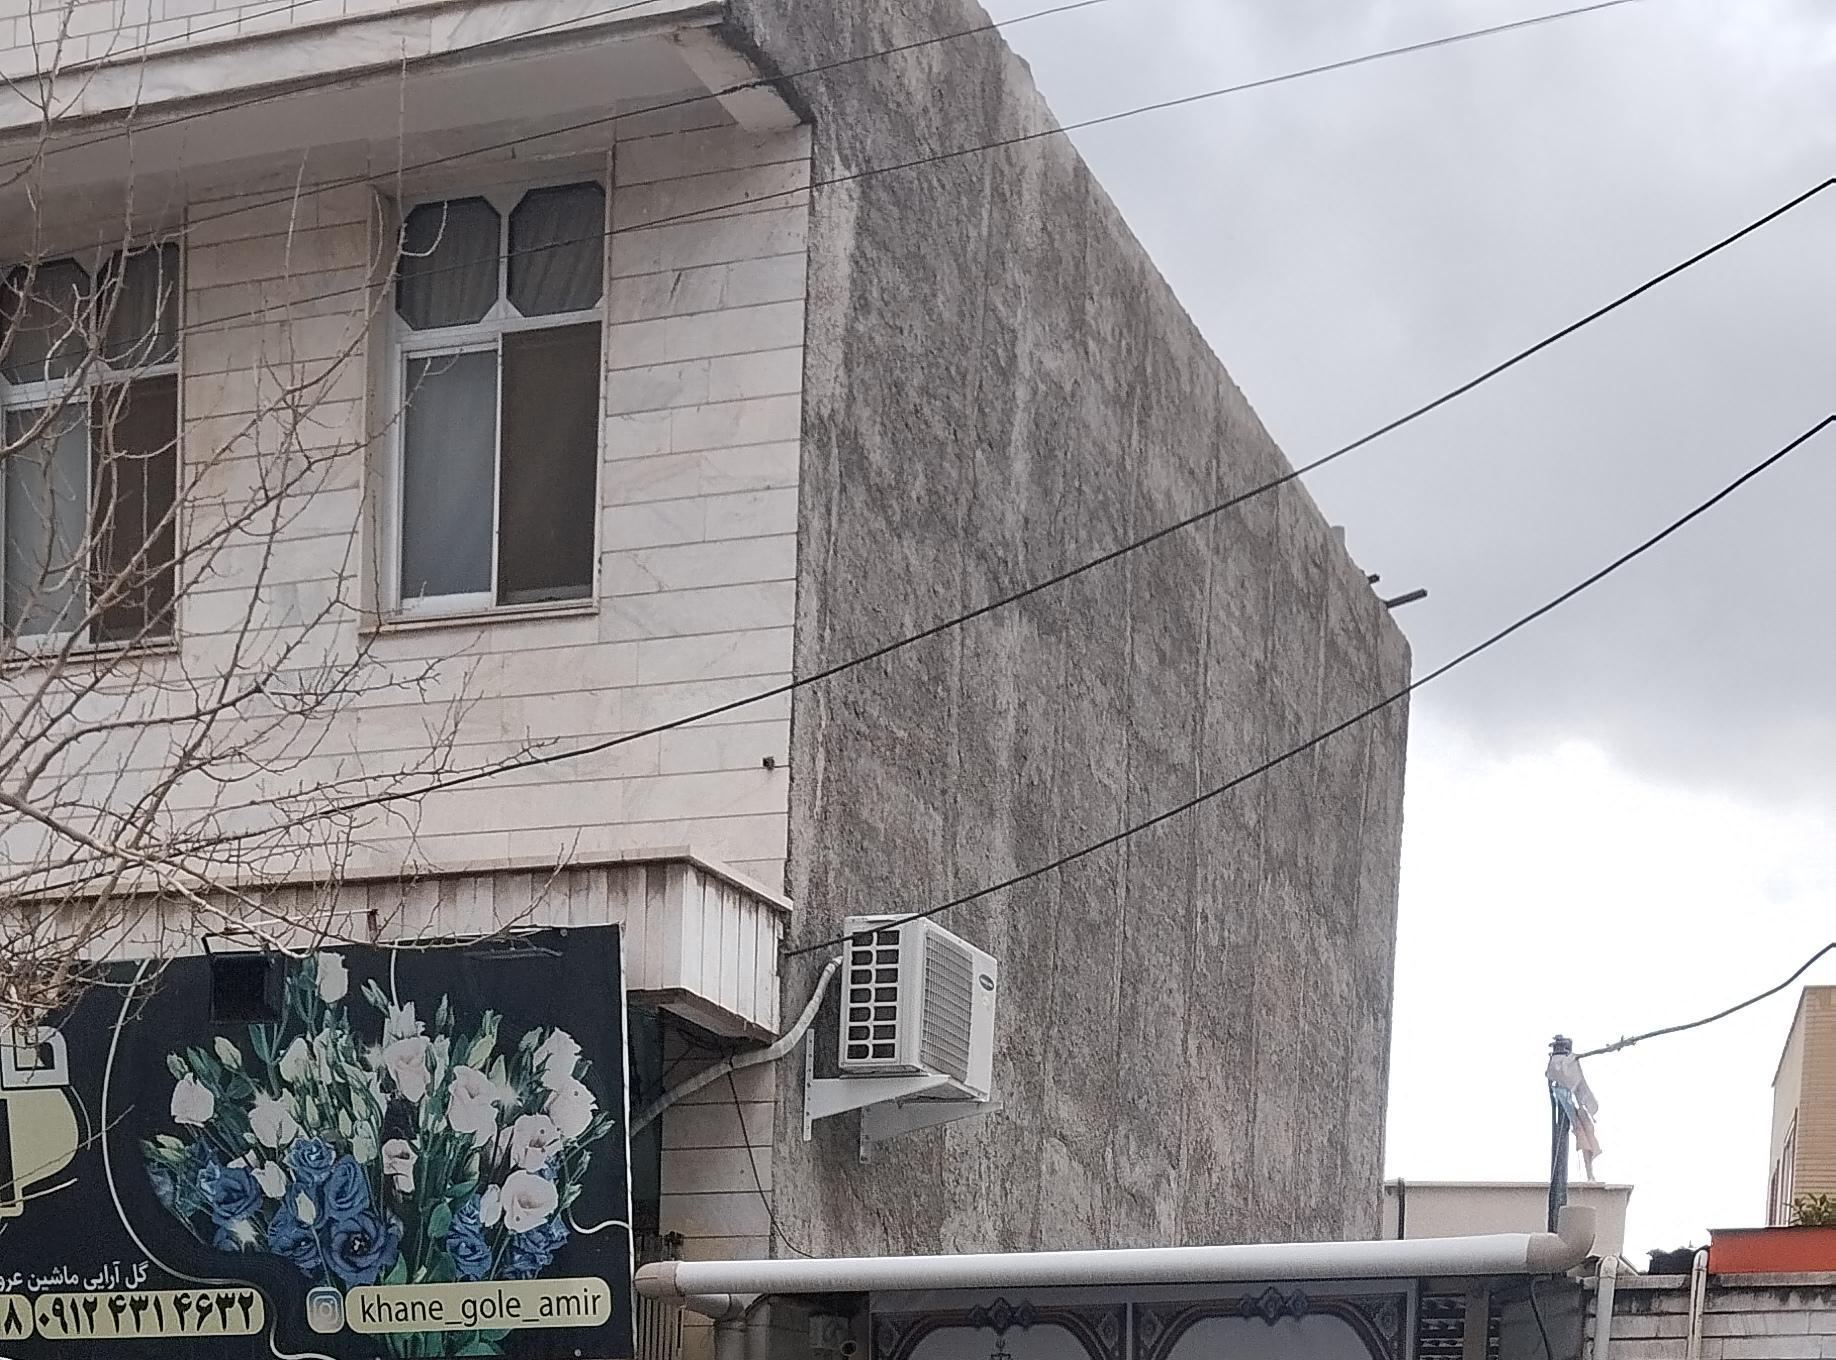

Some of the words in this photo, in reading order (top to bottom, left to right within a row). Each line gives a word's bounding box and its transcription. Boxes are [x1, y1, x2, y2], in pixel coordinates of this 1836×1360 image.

[27, 1265, 79, 1292] ماشین
[83, 1261, 121, 1291] آرایی
[125, 1261, 149, 1289] گل
[38, 1297, 98, 1335] ۰۹۱۲
[108, 1295, 164, 1334] ۴۳۱
[173, 1291, 254, 1332] ۴۶۳۲
[360, 1288, 602, 1327] khane_gole_amir
